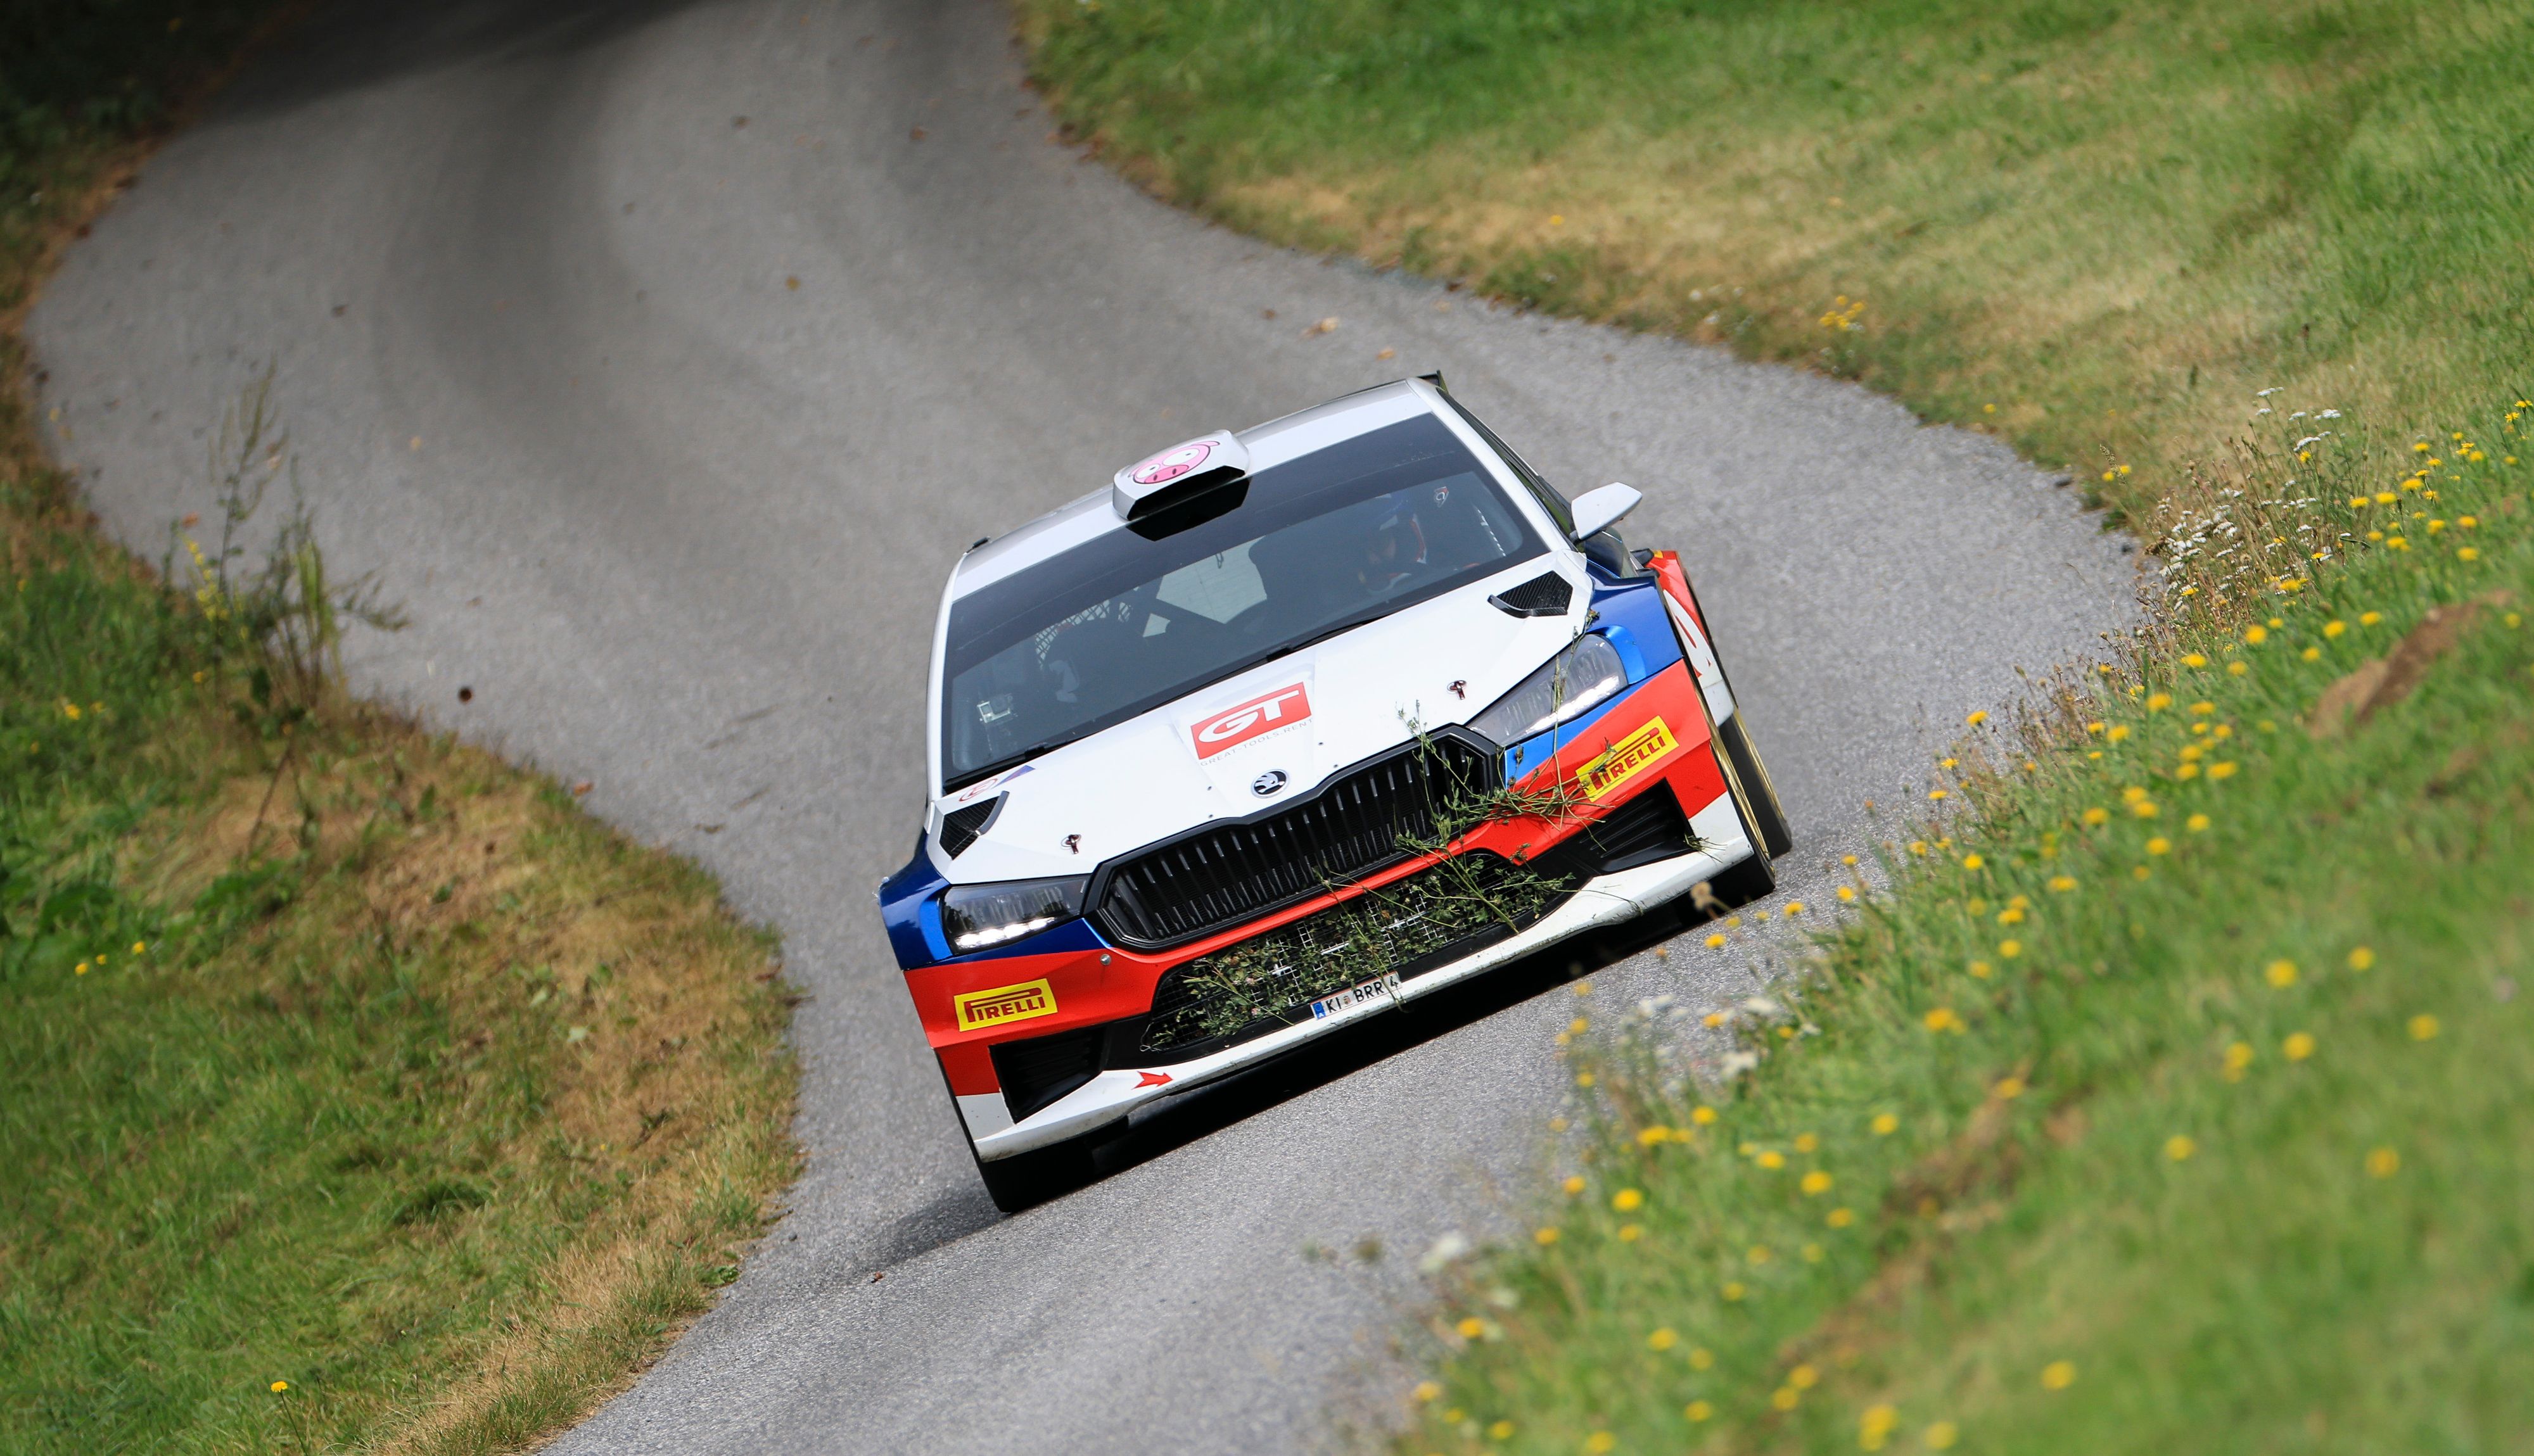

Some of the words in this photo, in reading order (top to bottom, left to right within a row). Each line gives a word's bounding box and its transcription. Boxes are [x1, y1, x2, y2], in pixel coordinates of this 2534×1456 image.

[1198, 689, 1300, 743] GT
[1200, 719, 1313, 766] GREAT-TOOLS.RENT
[1589, 727, 1665, 790] PIRELLI
[964, 987, 1045, 1023] PIRELLI
[1326, 997, 1342, 1013] KI
[1354, 982, 1384, 1003] BRR
